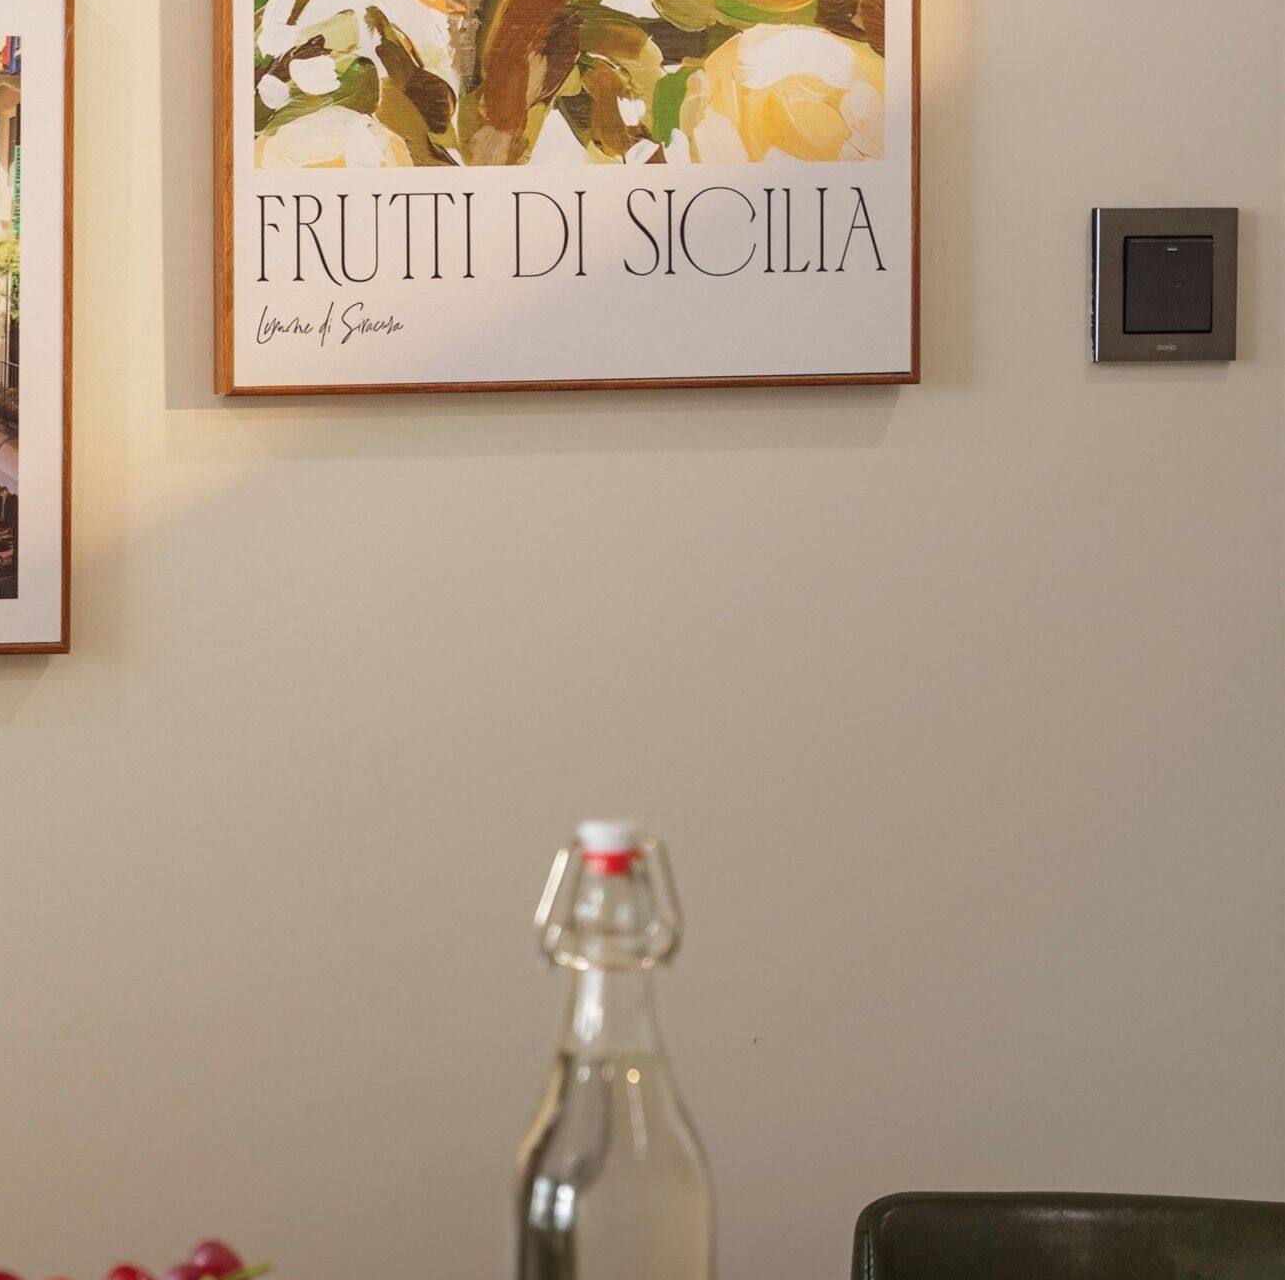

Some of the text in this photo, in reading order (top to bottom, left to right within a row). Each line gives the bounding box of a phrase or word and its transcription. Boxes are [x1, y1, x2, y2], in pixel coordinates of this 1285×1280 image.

[255, 186, 888, 287] FRUTTI DI SICILIA
[318, 301, 335, 348] di
